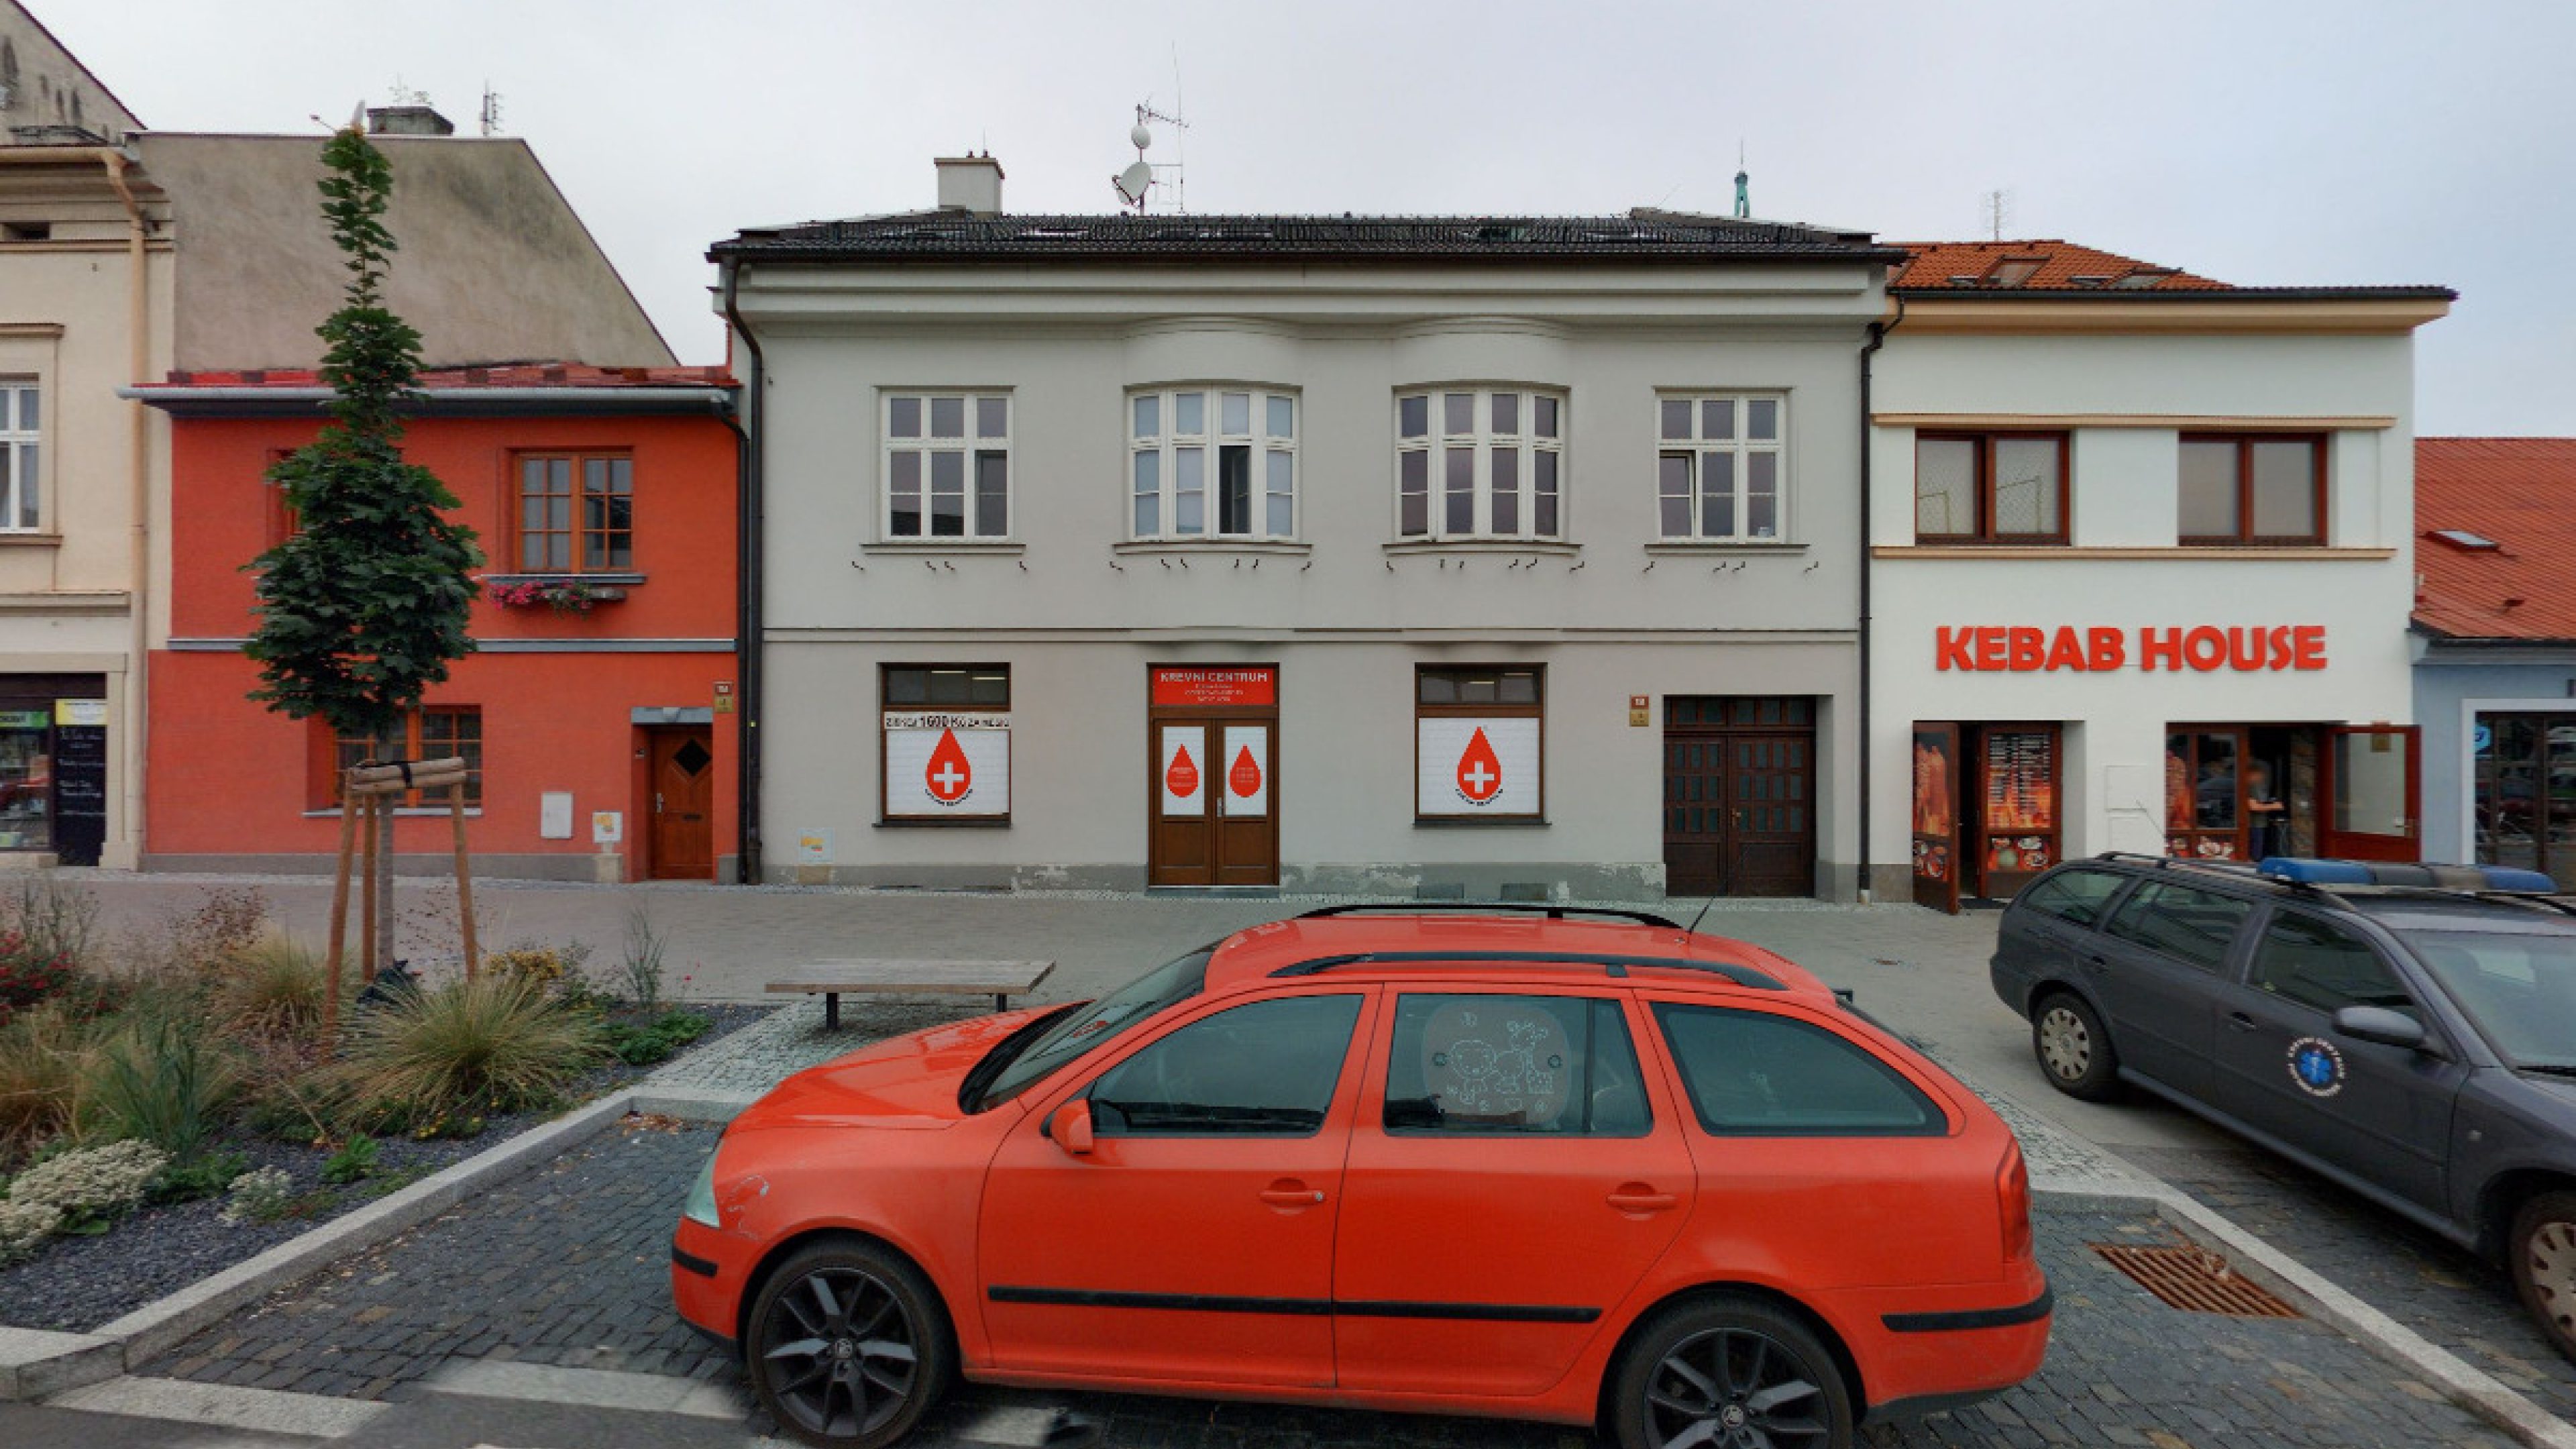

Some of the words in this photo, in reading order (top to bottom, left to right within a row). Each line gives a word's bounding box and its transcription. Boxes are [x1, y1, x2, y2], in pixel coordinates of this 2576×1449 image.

[1936, 625, 2125, 671] KEBAB
[2140, 625, 2326, 671] HOUSE
[1208, 672, 1267, 682] CENTRUM
